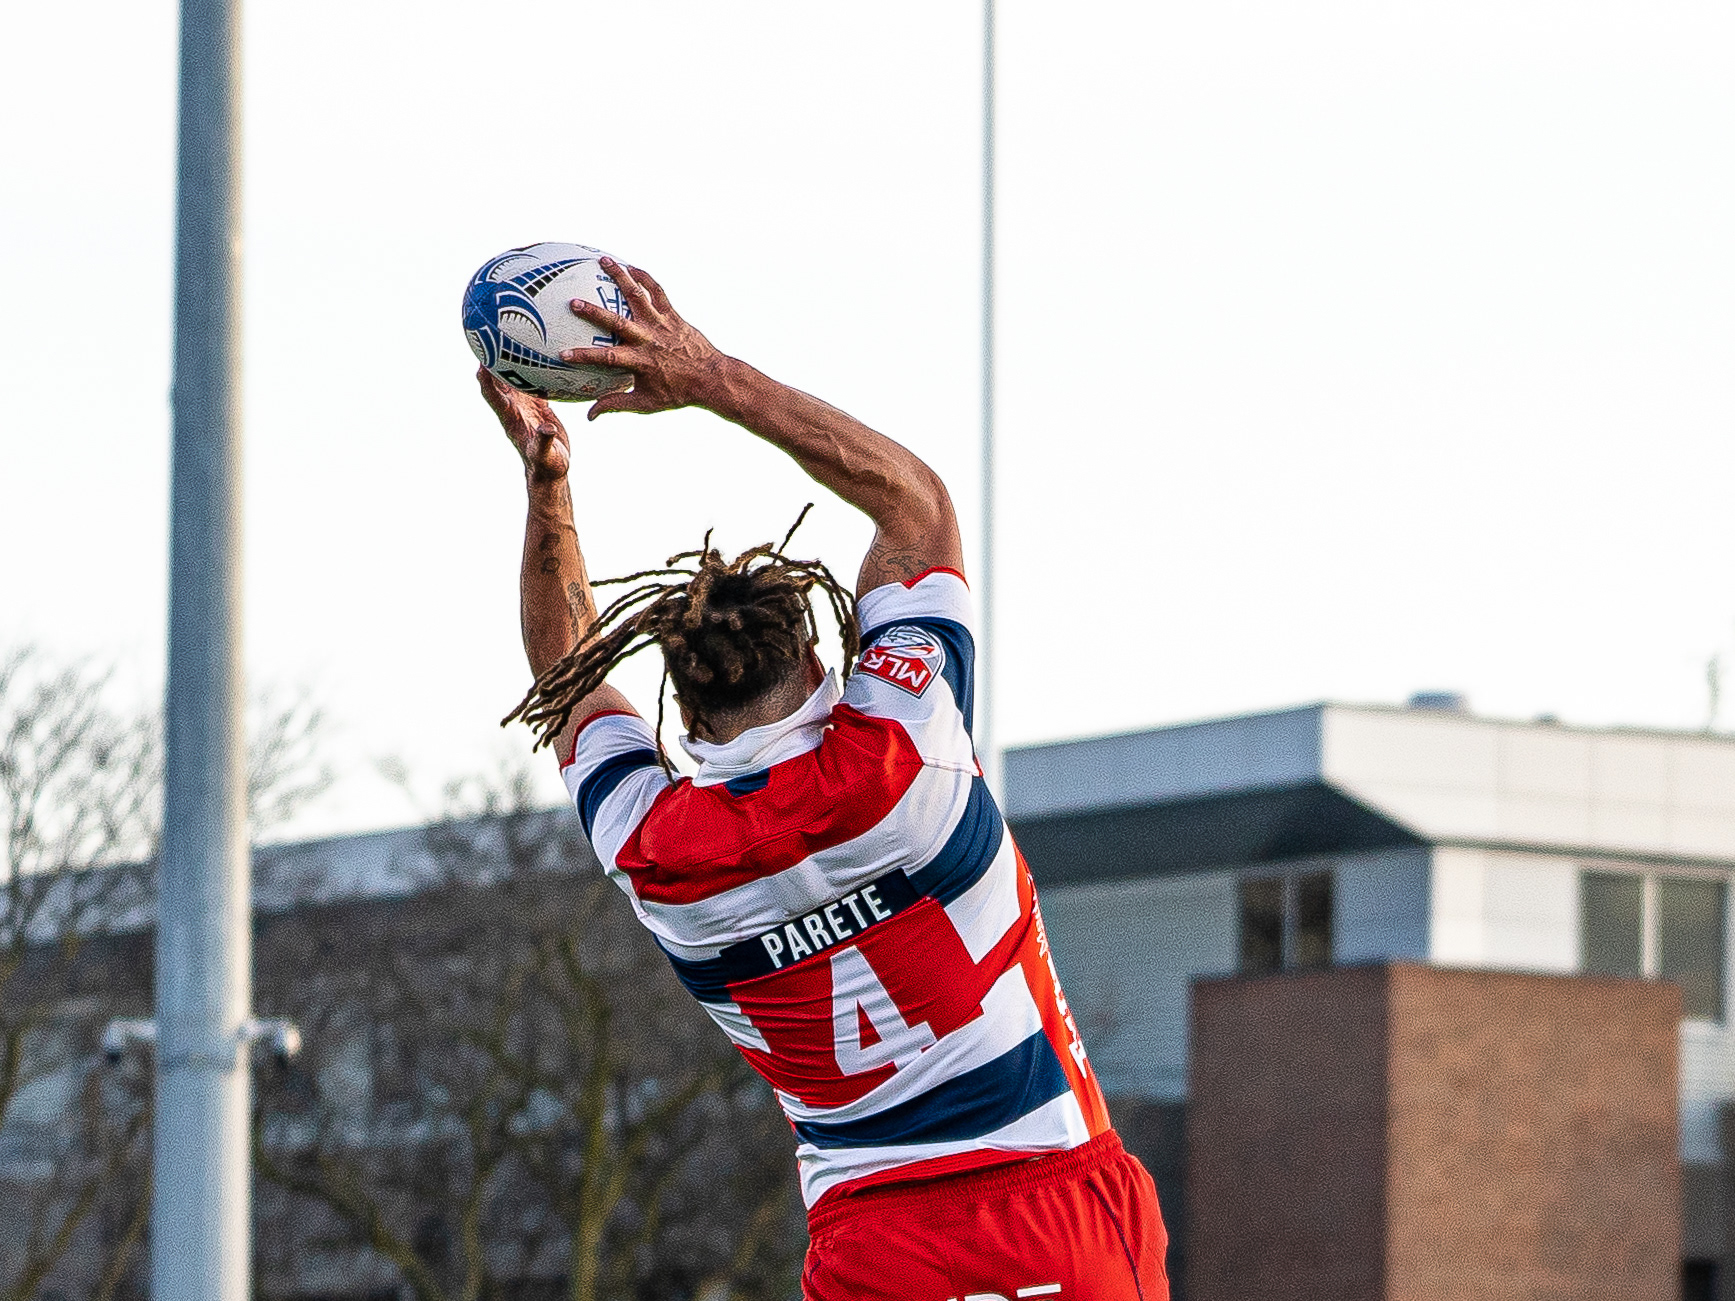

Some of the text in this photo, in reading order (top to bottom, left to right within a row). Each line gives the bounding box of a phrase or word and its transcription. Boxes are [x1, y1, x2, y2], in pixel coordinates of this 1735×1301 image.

[863, 653, 929, 687] MLR
[760, 884, 892, 969] PARETE
[830, 944, 937, 1077] 4
